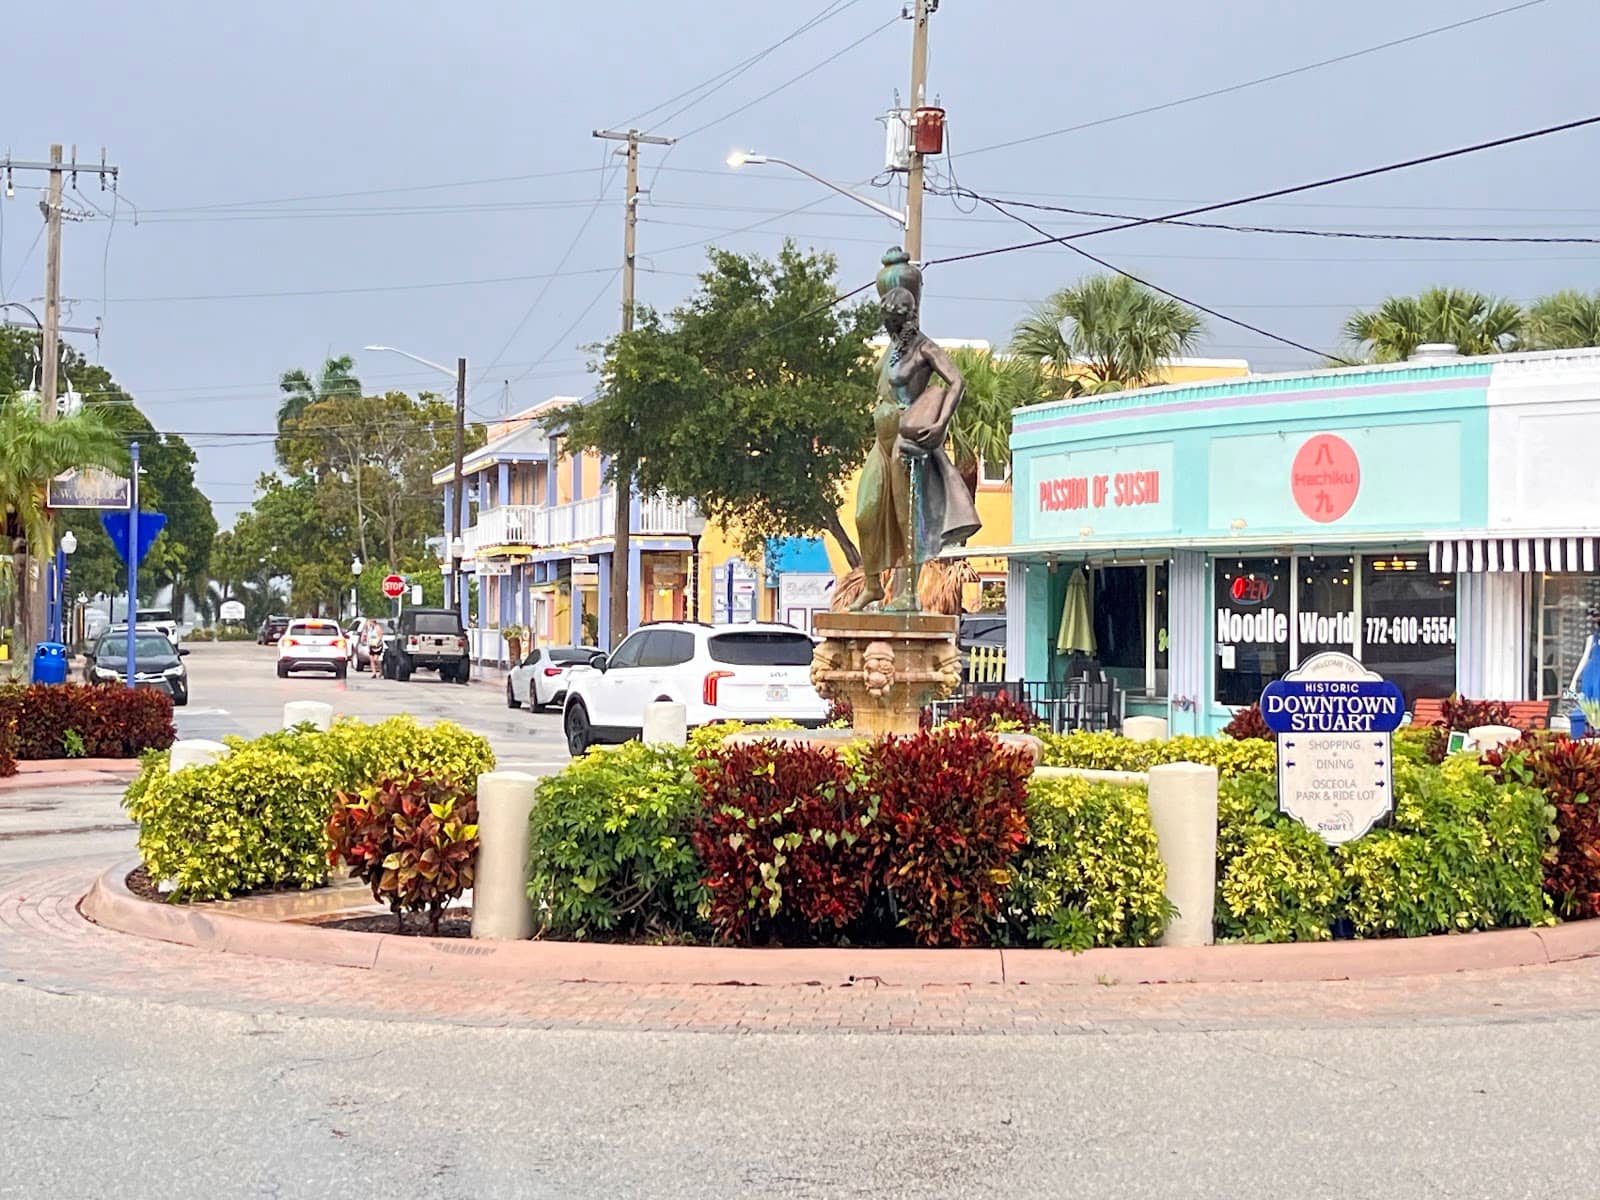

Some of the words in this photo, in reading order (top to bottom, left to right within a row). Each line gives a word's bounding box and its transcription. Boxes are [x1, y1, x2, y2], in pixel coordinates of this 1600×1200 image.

[1315, 444, 1334, 466] 八
[1039, 477, 1088, 512] PASSION
[1093, 474, 1109, 508] OF
[1114, 471, 1159, 507] SUSHI
[1315, 490, 1334, 512] 九
[384, 582, 403, 591] STOP
[1232, 576, 1269, 600] OPEN
[1218, 608, 1287, 643] Noodle
[1299, 611, 1355, 644] World
[1366, 616, 1456, 644] 772-600-5554
[1305, 683, 1359, 693] HISTORIC
[1267, 696, 1396, 714] DOWNTOWN
[1291, 714, 1375, 731] STUART
[1309, 740, 1360, 750] SHOPPING
[1316, 760, 1354, 769] DINING
[1312, 780, 1357, 789] OSCEOLA
[1296, 791, 1321, 801] PARK
[1323, 791, 1331, 801] &
[1333, 791, 1354, 800] RIDE
[1357, 790, 1376, 800] LOT
[1317, 822, 1346, 831] Stuart
